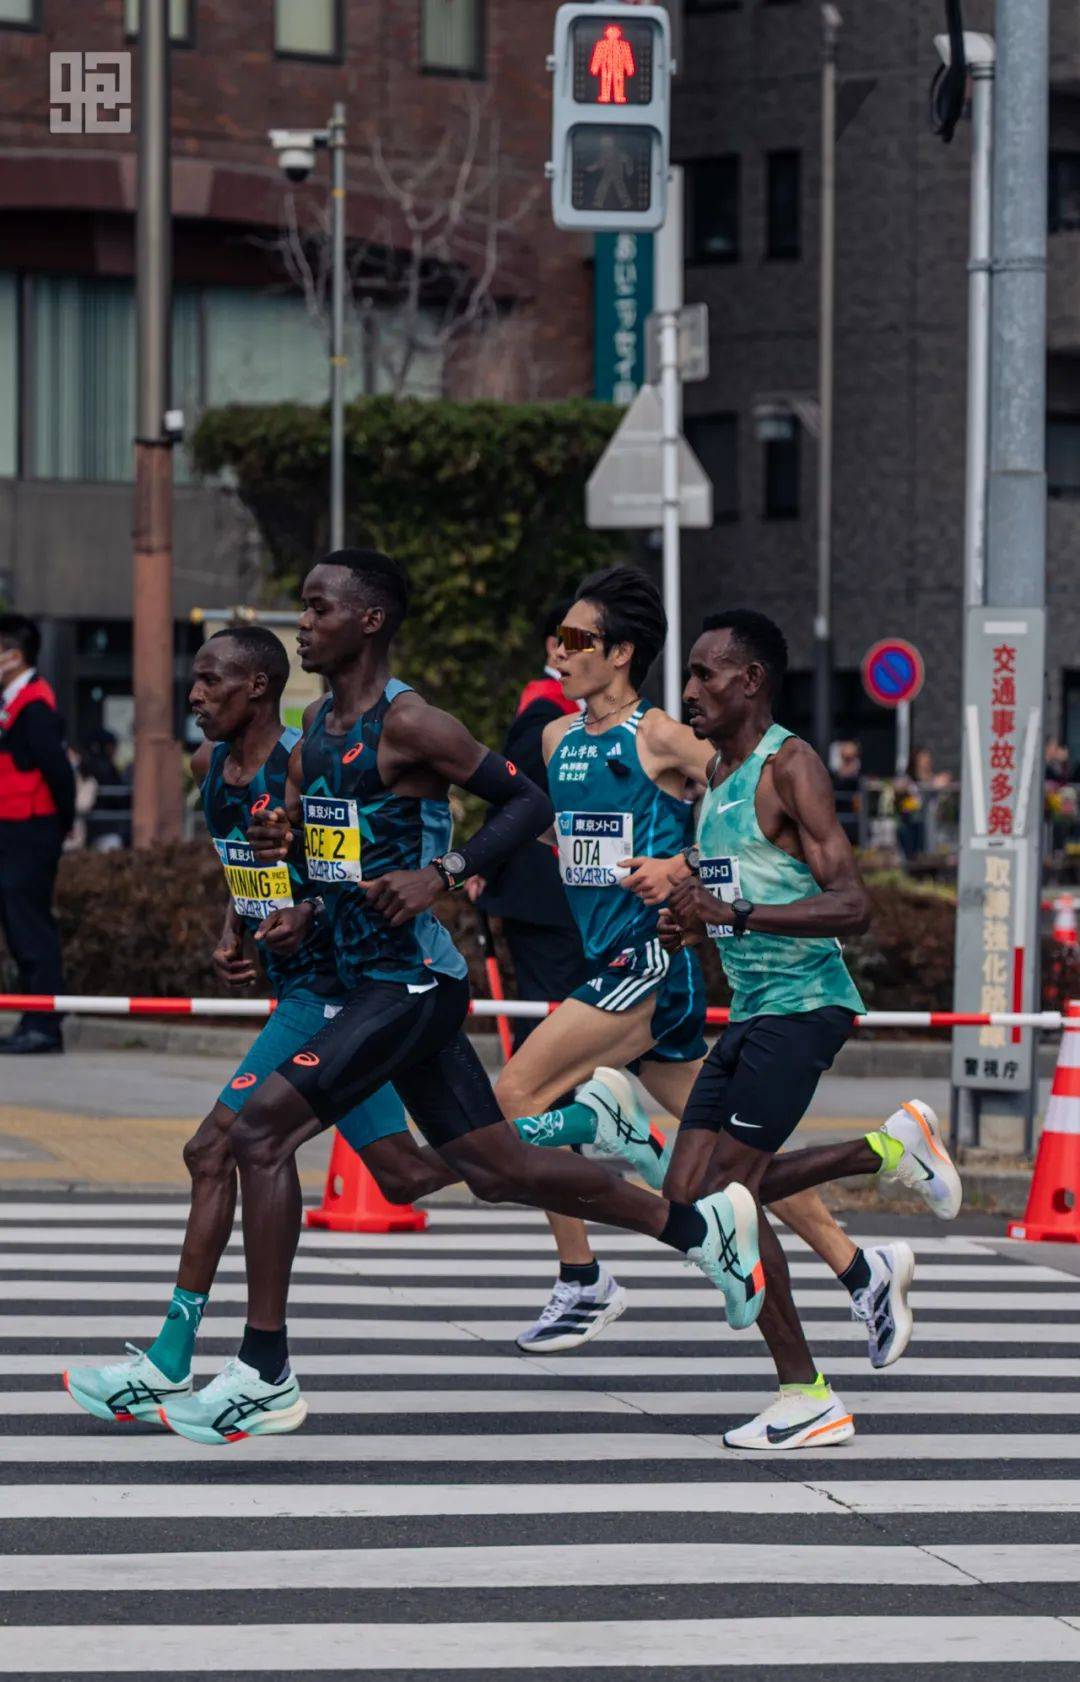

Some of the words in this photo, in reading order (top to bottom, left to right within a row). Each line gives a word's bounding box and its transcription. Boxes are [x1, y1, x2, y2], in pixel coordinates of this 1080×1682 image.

[987, 643, 1018, 836] 交通事故多発
[308, 805, 345, 820] 東京メトロ
[575, 819, 620, 832] 東京メトロ
[332, 829, 346, 860] 2
[573, 839, 600, 866] OTA
[275, 882, 288, 895] 23
[964, 1056, 1019, 1078] 警視庁
